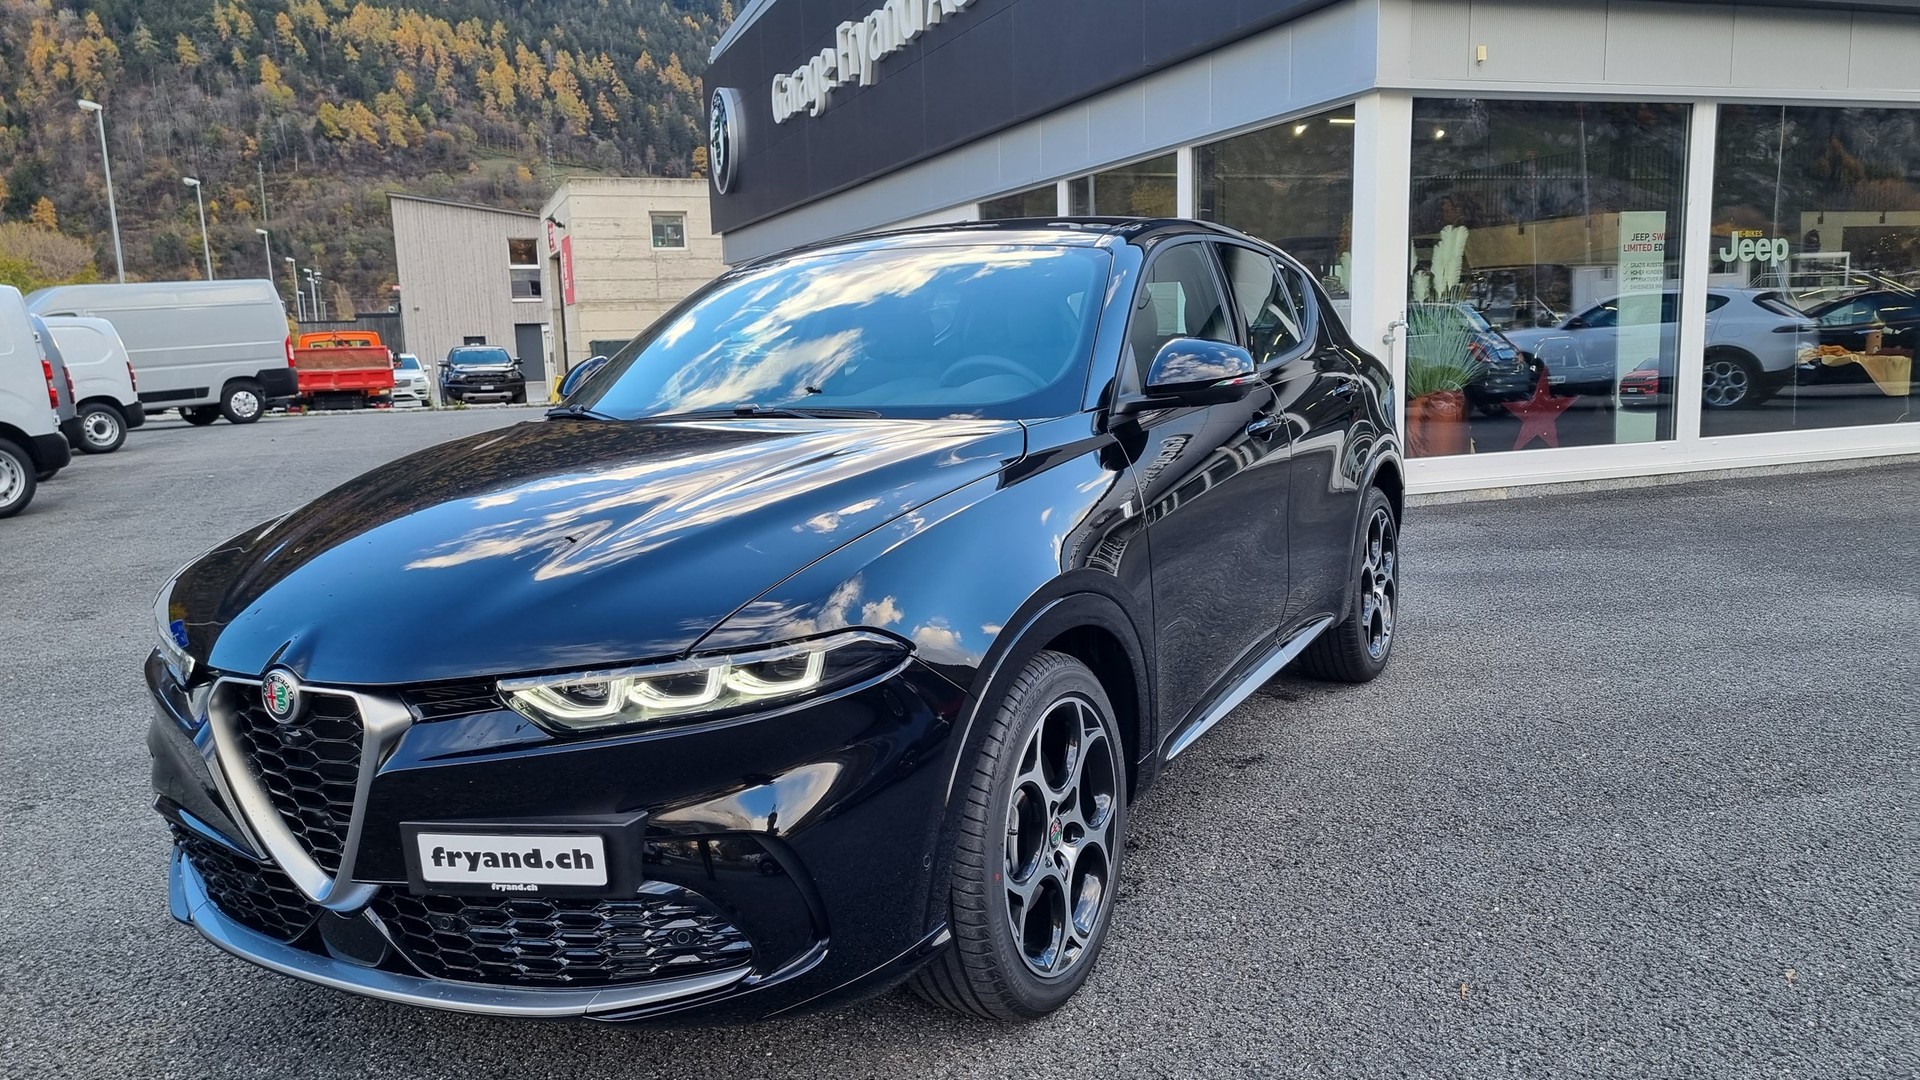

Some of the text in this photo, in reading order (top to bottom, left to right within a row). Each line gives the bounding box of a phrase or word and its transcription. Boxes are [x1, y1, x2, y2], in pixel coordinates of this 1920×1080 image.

[772, 48, 837, 124] Garage
[1631, 233, 1650, 242] JEEP,
[1739, 230, 1763, 238] E-BIKES
[1623, 244, 1652, 252] LIMITED
[1719, 230, 1789, 267] Jeep
[431, 846, 595, 872] fryand.ch
[491, 882, 539, 892] fryand.ch
